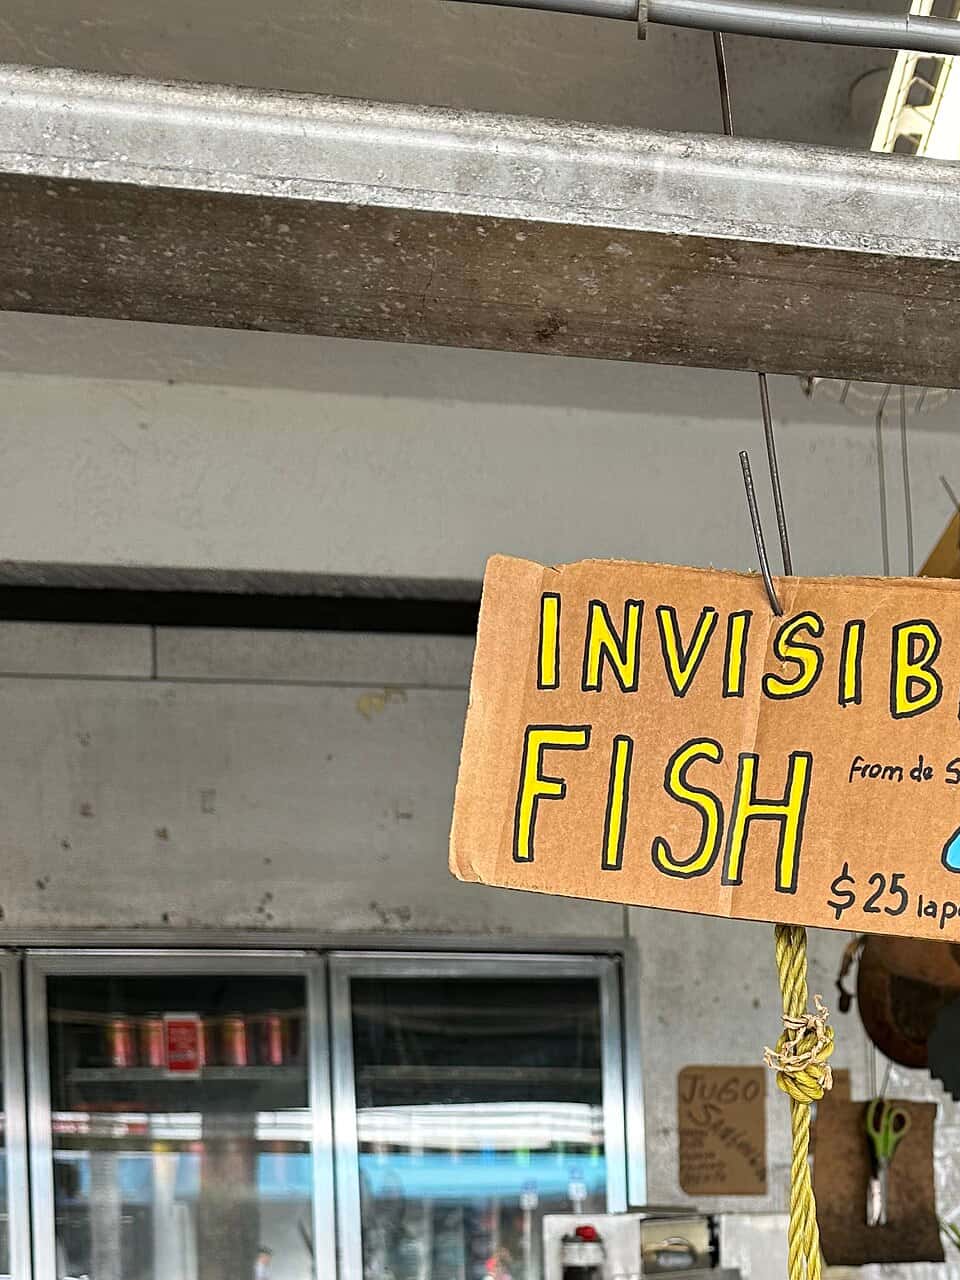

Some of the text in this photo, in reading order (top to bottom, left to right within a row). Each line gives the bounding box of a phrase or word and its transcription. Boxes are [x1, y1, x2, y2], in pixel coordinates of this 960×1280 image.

[513, 725, 813, 893] FISH
[849, 755, 903, 783] from
[909, 754, 933, 782] de
